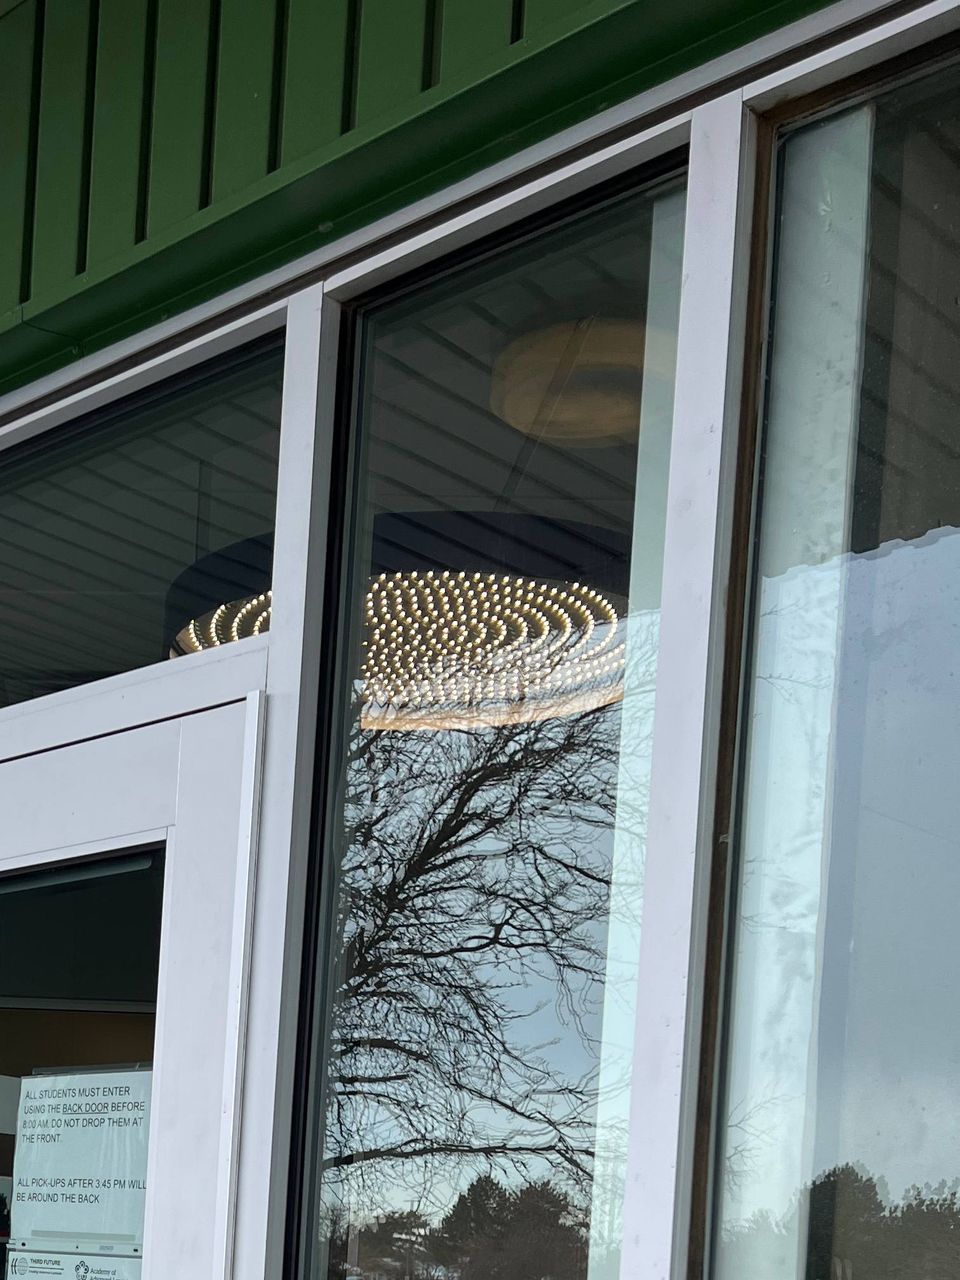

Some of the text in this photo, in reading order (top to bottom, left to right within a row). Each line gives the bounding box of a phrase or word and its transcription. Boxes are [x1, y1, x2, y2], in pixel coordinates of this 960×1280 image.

[25, 1086, 131, 1100] ALL STUDENTS MUST ENTER
[24, 1101, 145, 1115] USING THE BACK DOOR BEFORE
[51, 1118, 63, 1128] DO
[63, 1118, 80, 1128] NOT
[81, 1117, 106, 1128] DROP
[107, 1117, 131, 1127] THEM
[131, 1116, 144, 1127] AT
[22, 1134, 35, 1144] THE
[17, 1178, 30, 1187] ALL
[31, 1177, 66, 1188] PICK-UPS
[67, 1178, 94, 1188] AFTER
[113, 1179, 126, 1189] PM
[127, 1179, 147, 1190] WILL
[16, 1192, 26, 1202] BE
[27, 1192, 59, 1203] AROUND
[60, 1193, 76, 1203] THE
